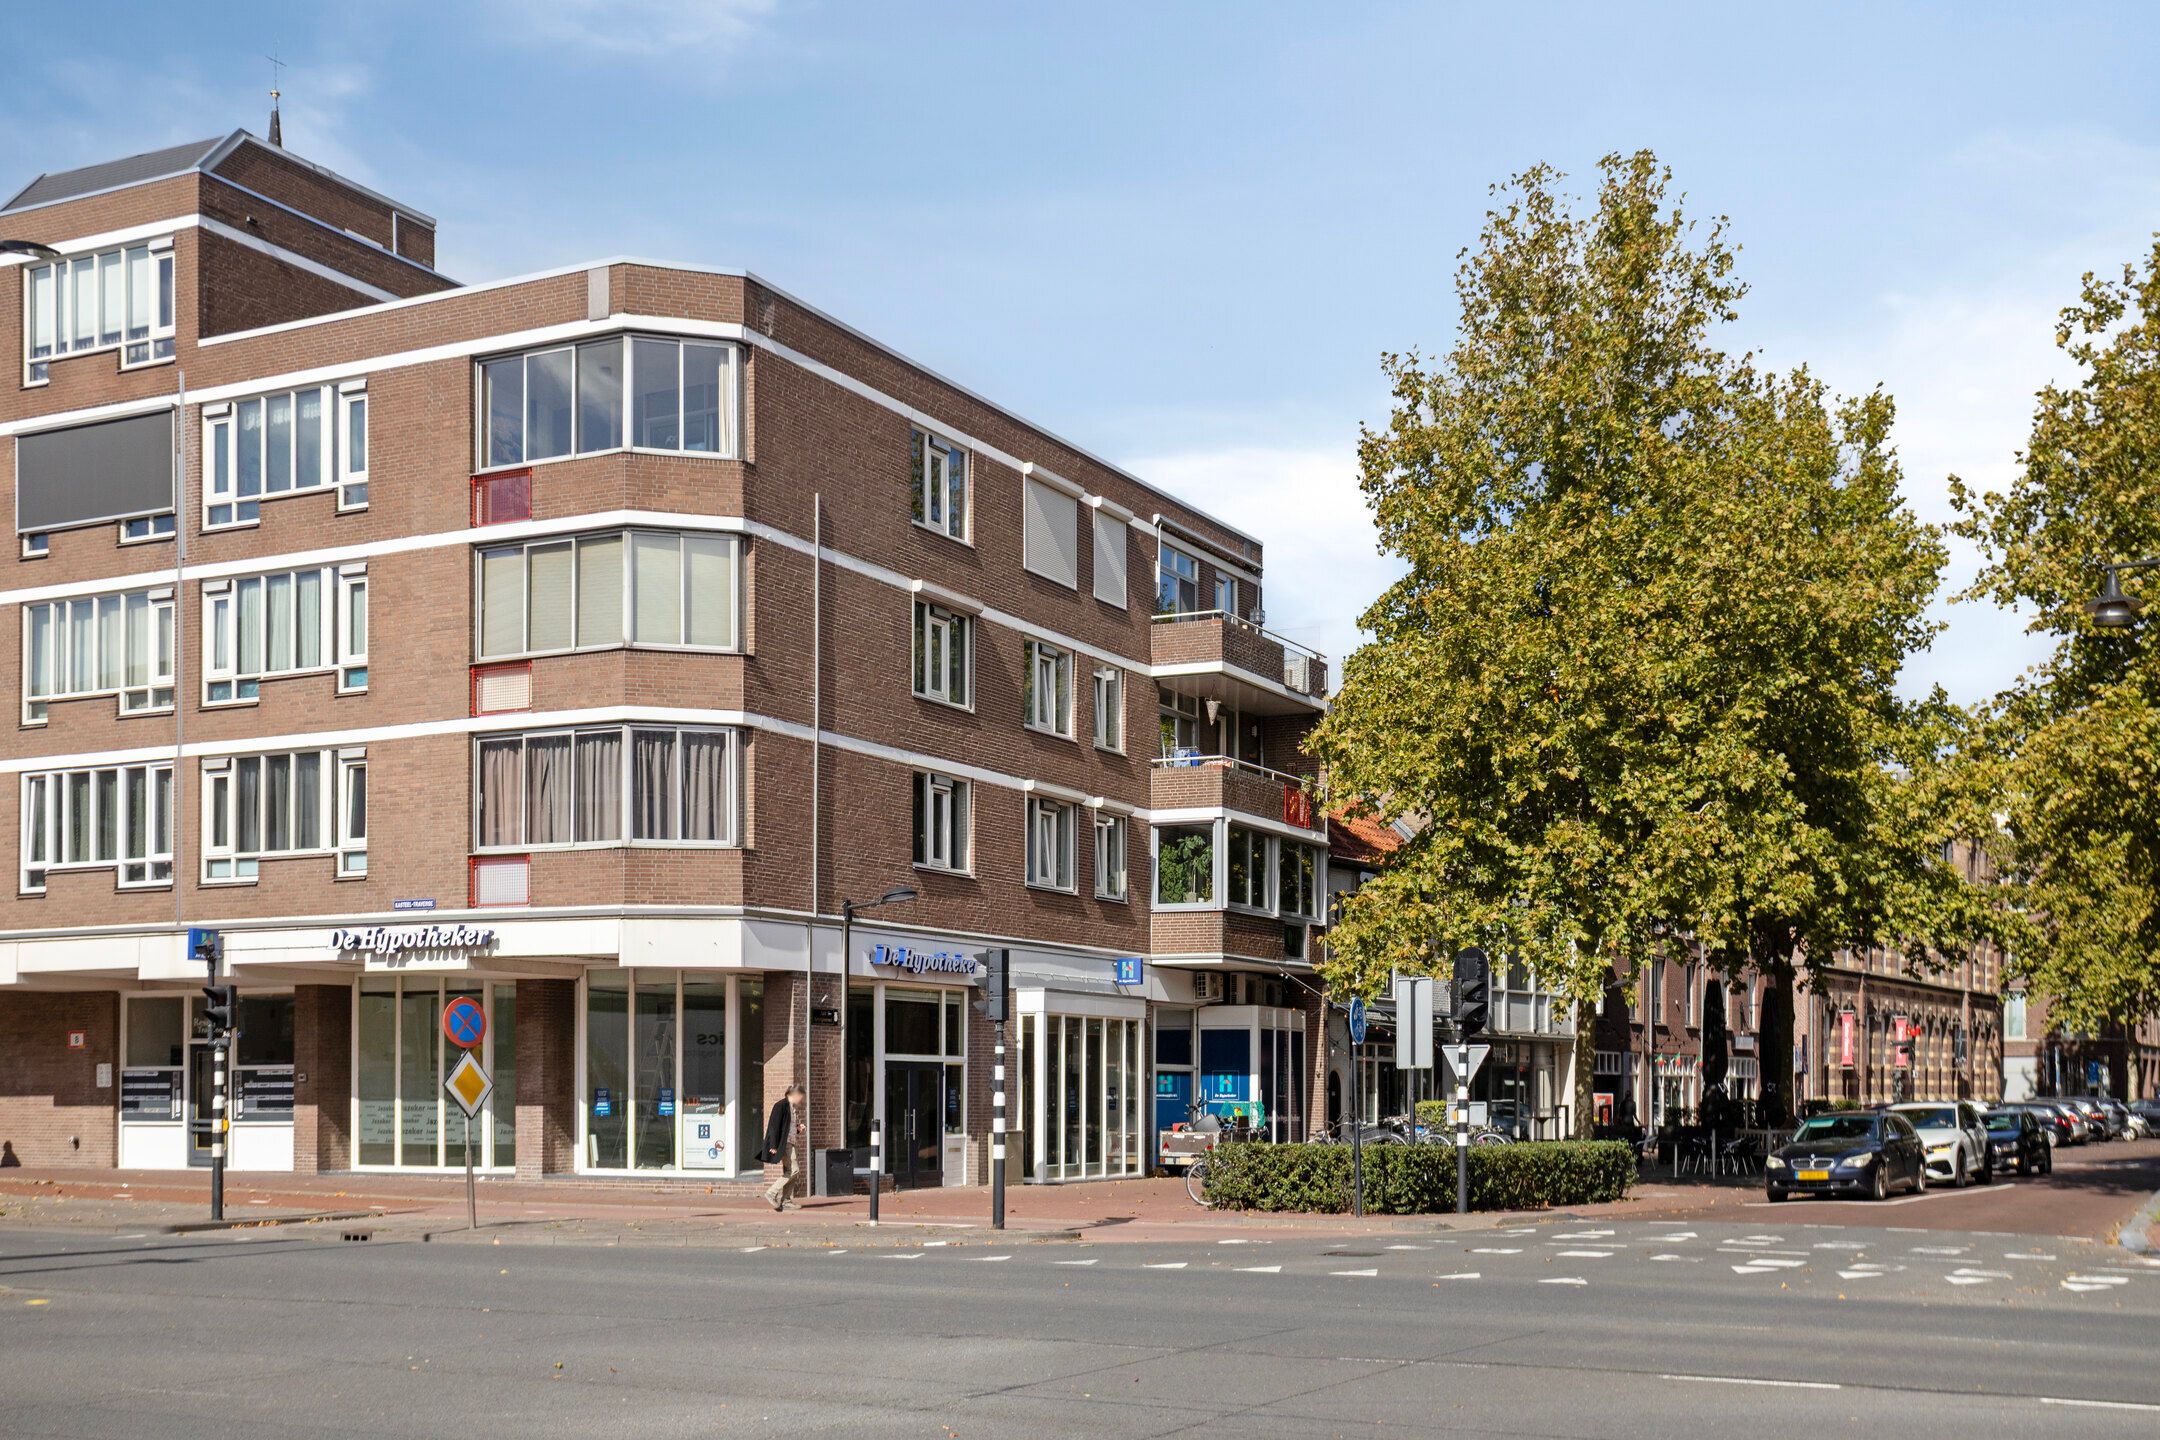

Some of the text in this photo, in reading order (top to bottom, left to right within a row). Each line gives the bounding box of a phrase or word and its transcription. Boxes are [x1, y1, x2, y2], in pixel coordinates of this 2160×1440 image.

[327, 926, 489, 954] De Hypotheker
[880, 944, 900, 967] De
[1121, 961, 1134, 979] H
[1219, 1074, 1233, 1093] H
